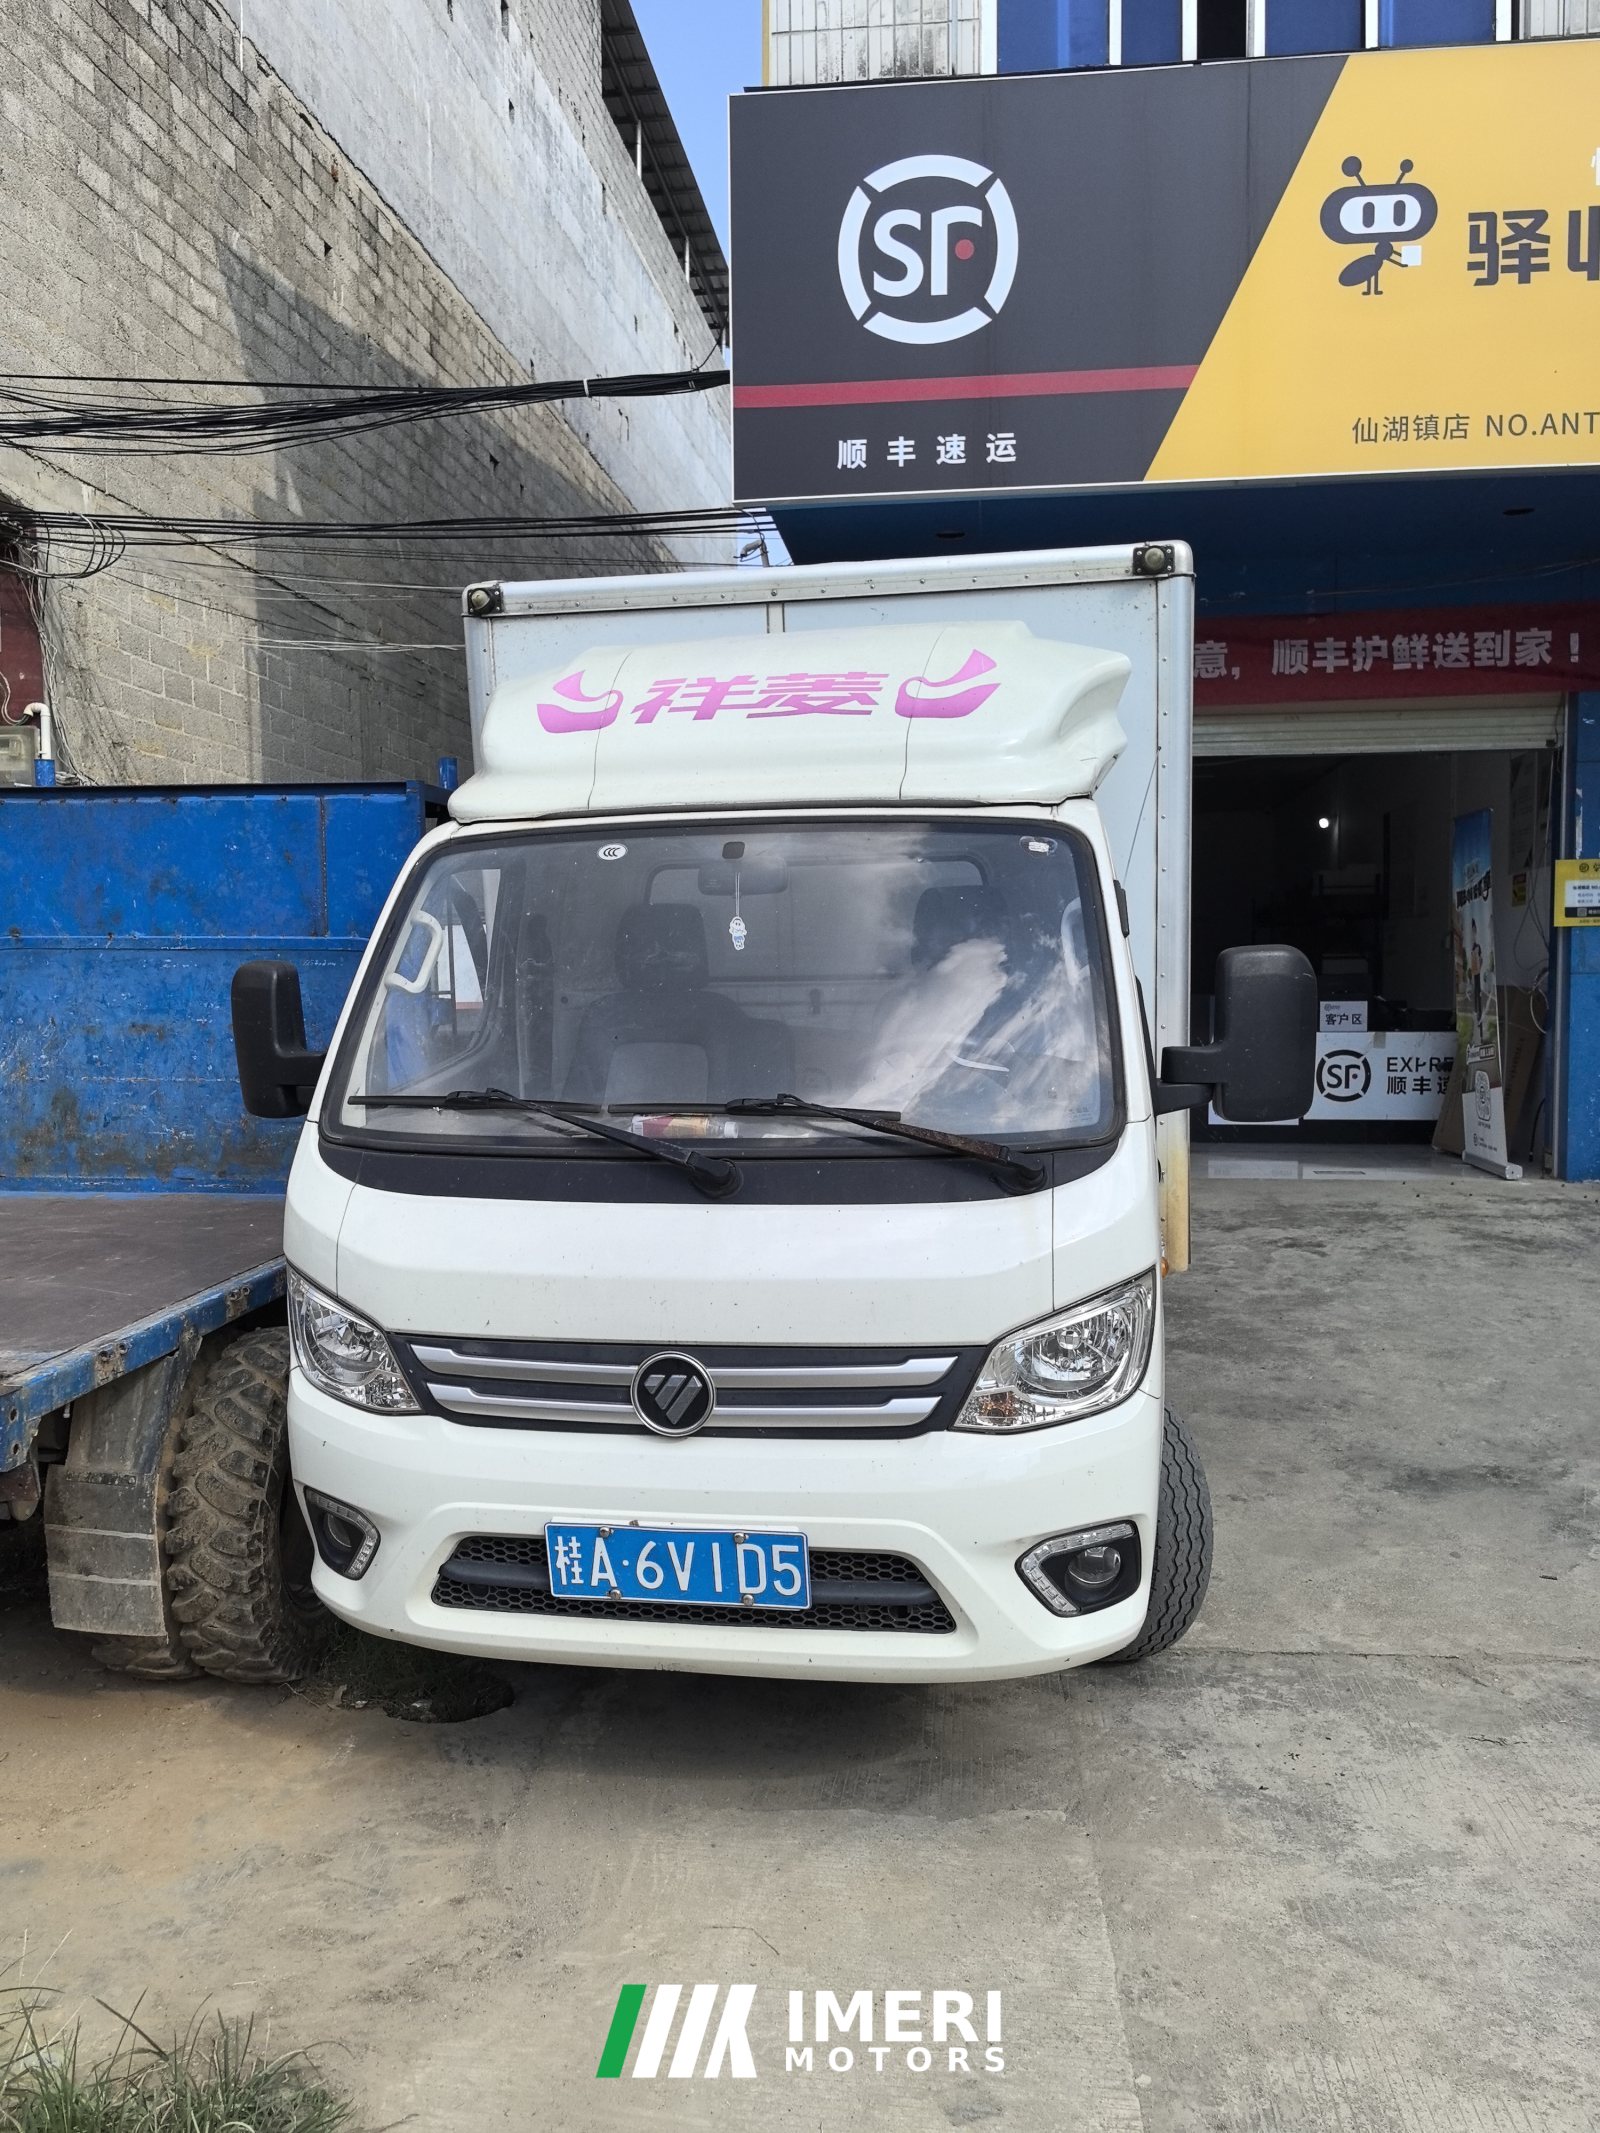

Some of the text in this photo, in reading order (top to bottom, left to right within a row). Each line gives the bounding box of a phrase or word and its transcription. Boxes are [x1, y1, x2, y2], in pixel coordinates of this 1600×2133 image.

[1352, 413, 1470, 444] 仙湖镇店
[837, 432, 1017, 470] 顺丰速运
[631, 671, 890, 724] 祥菱
[1325, 1012, 1362, 1025] 客户区
